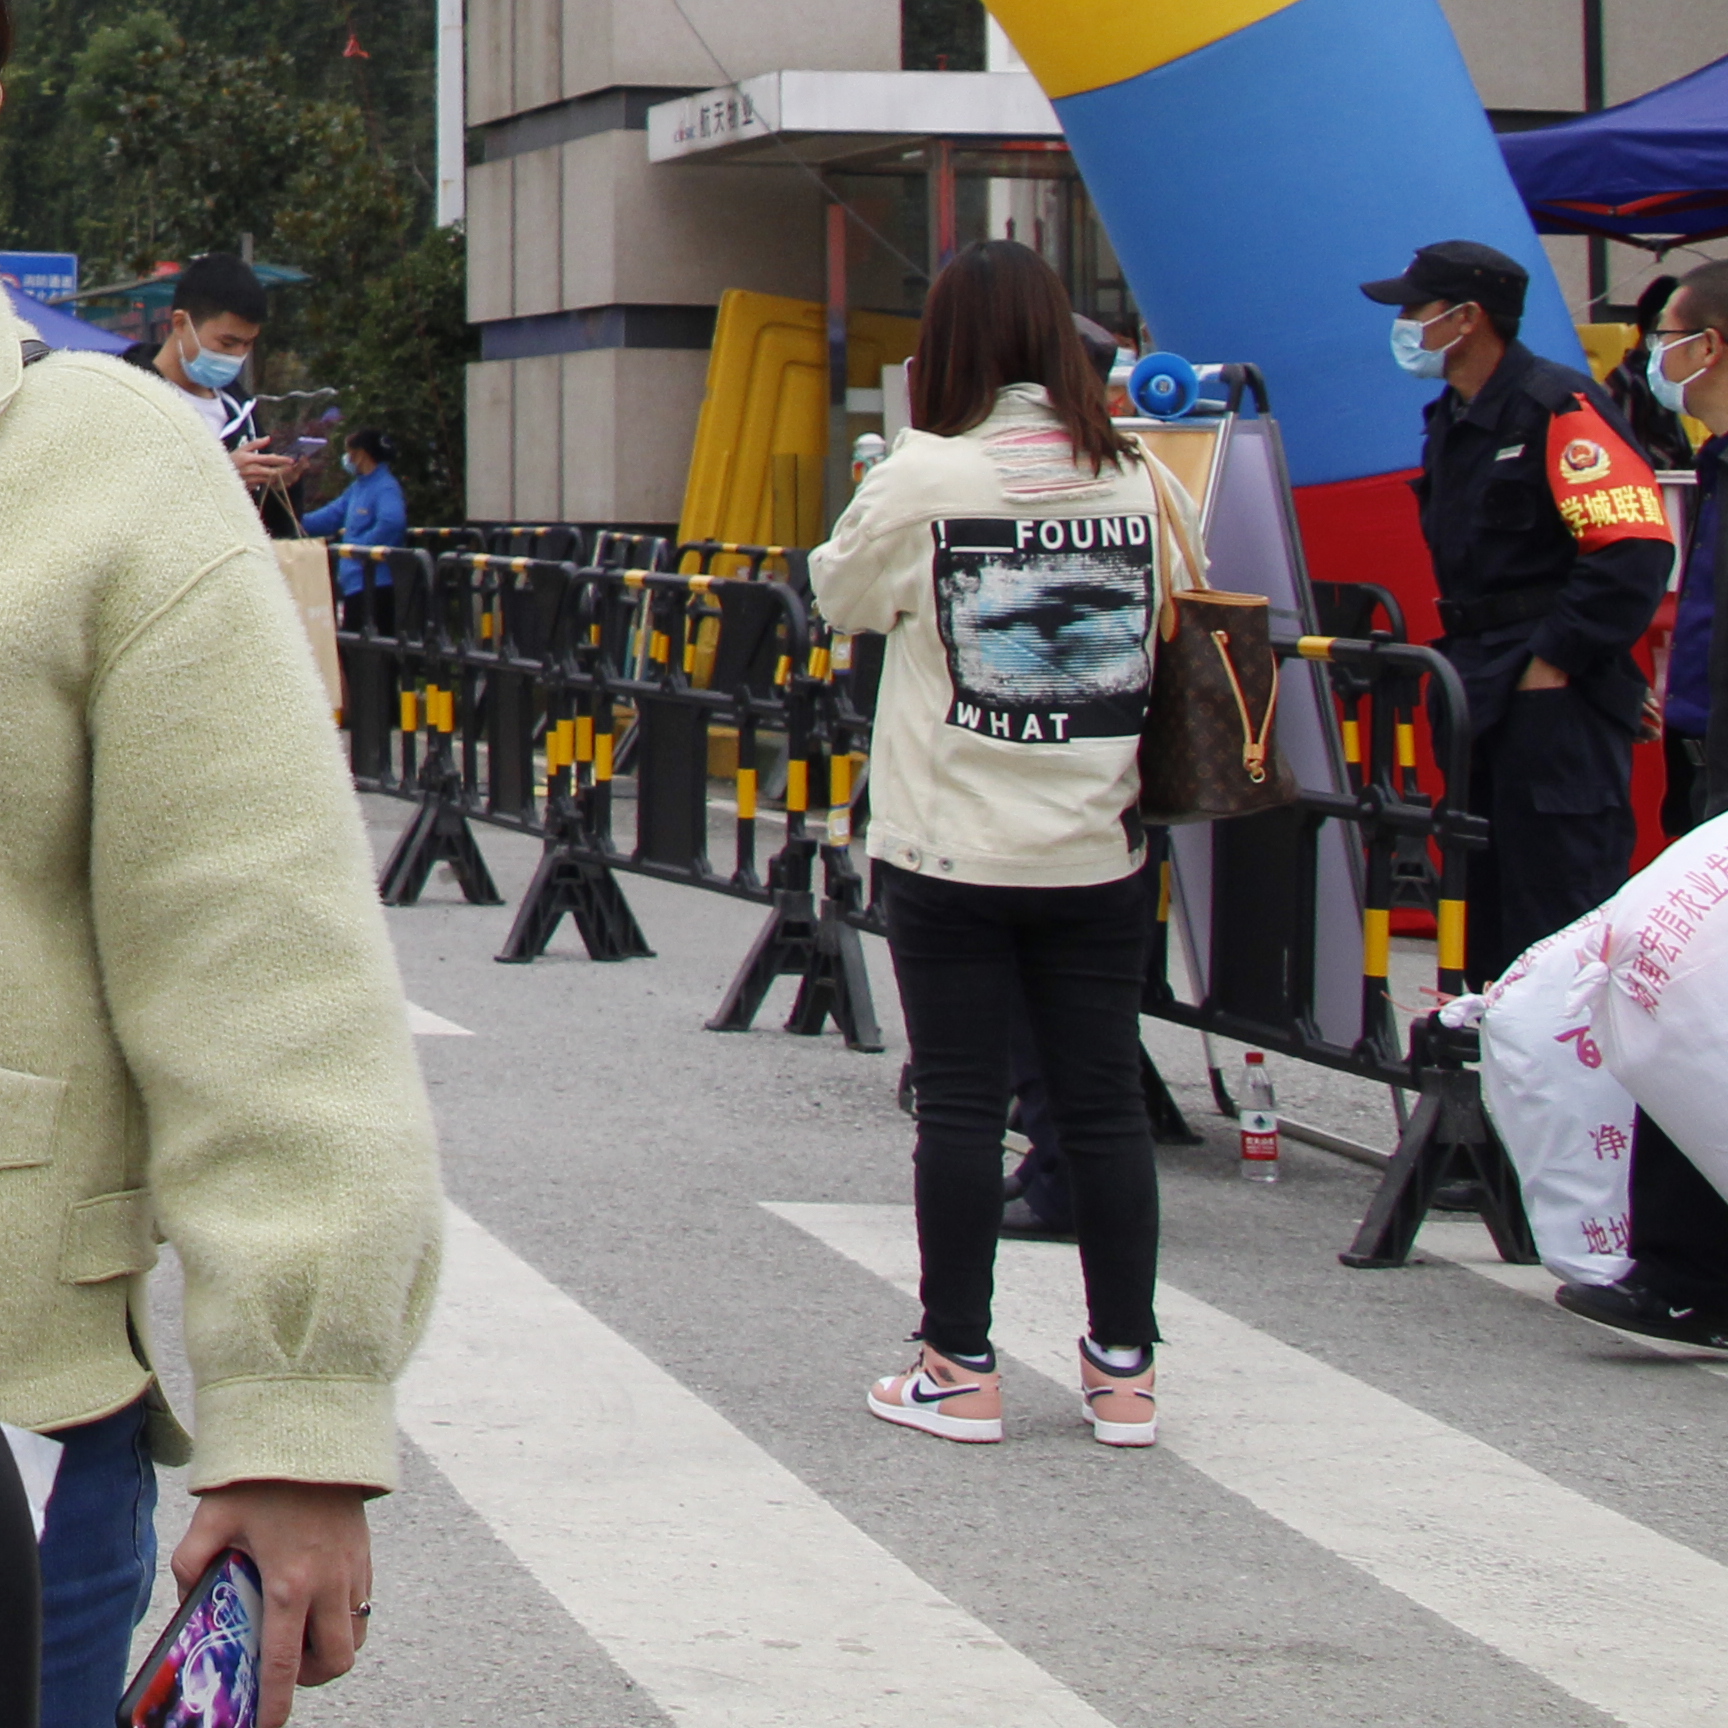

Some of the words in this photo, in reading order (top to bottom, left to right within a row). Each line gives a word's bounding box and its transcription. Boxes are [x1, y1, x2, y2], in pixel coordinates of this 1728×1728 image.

[1016, 515, 1146, 550] FOUND
[956, 702, 1070, 741] WHAT
[1627, 846, 1728, 1022] 湖南宏信农业发
[1588, 1122, 1636, 1160] 净
